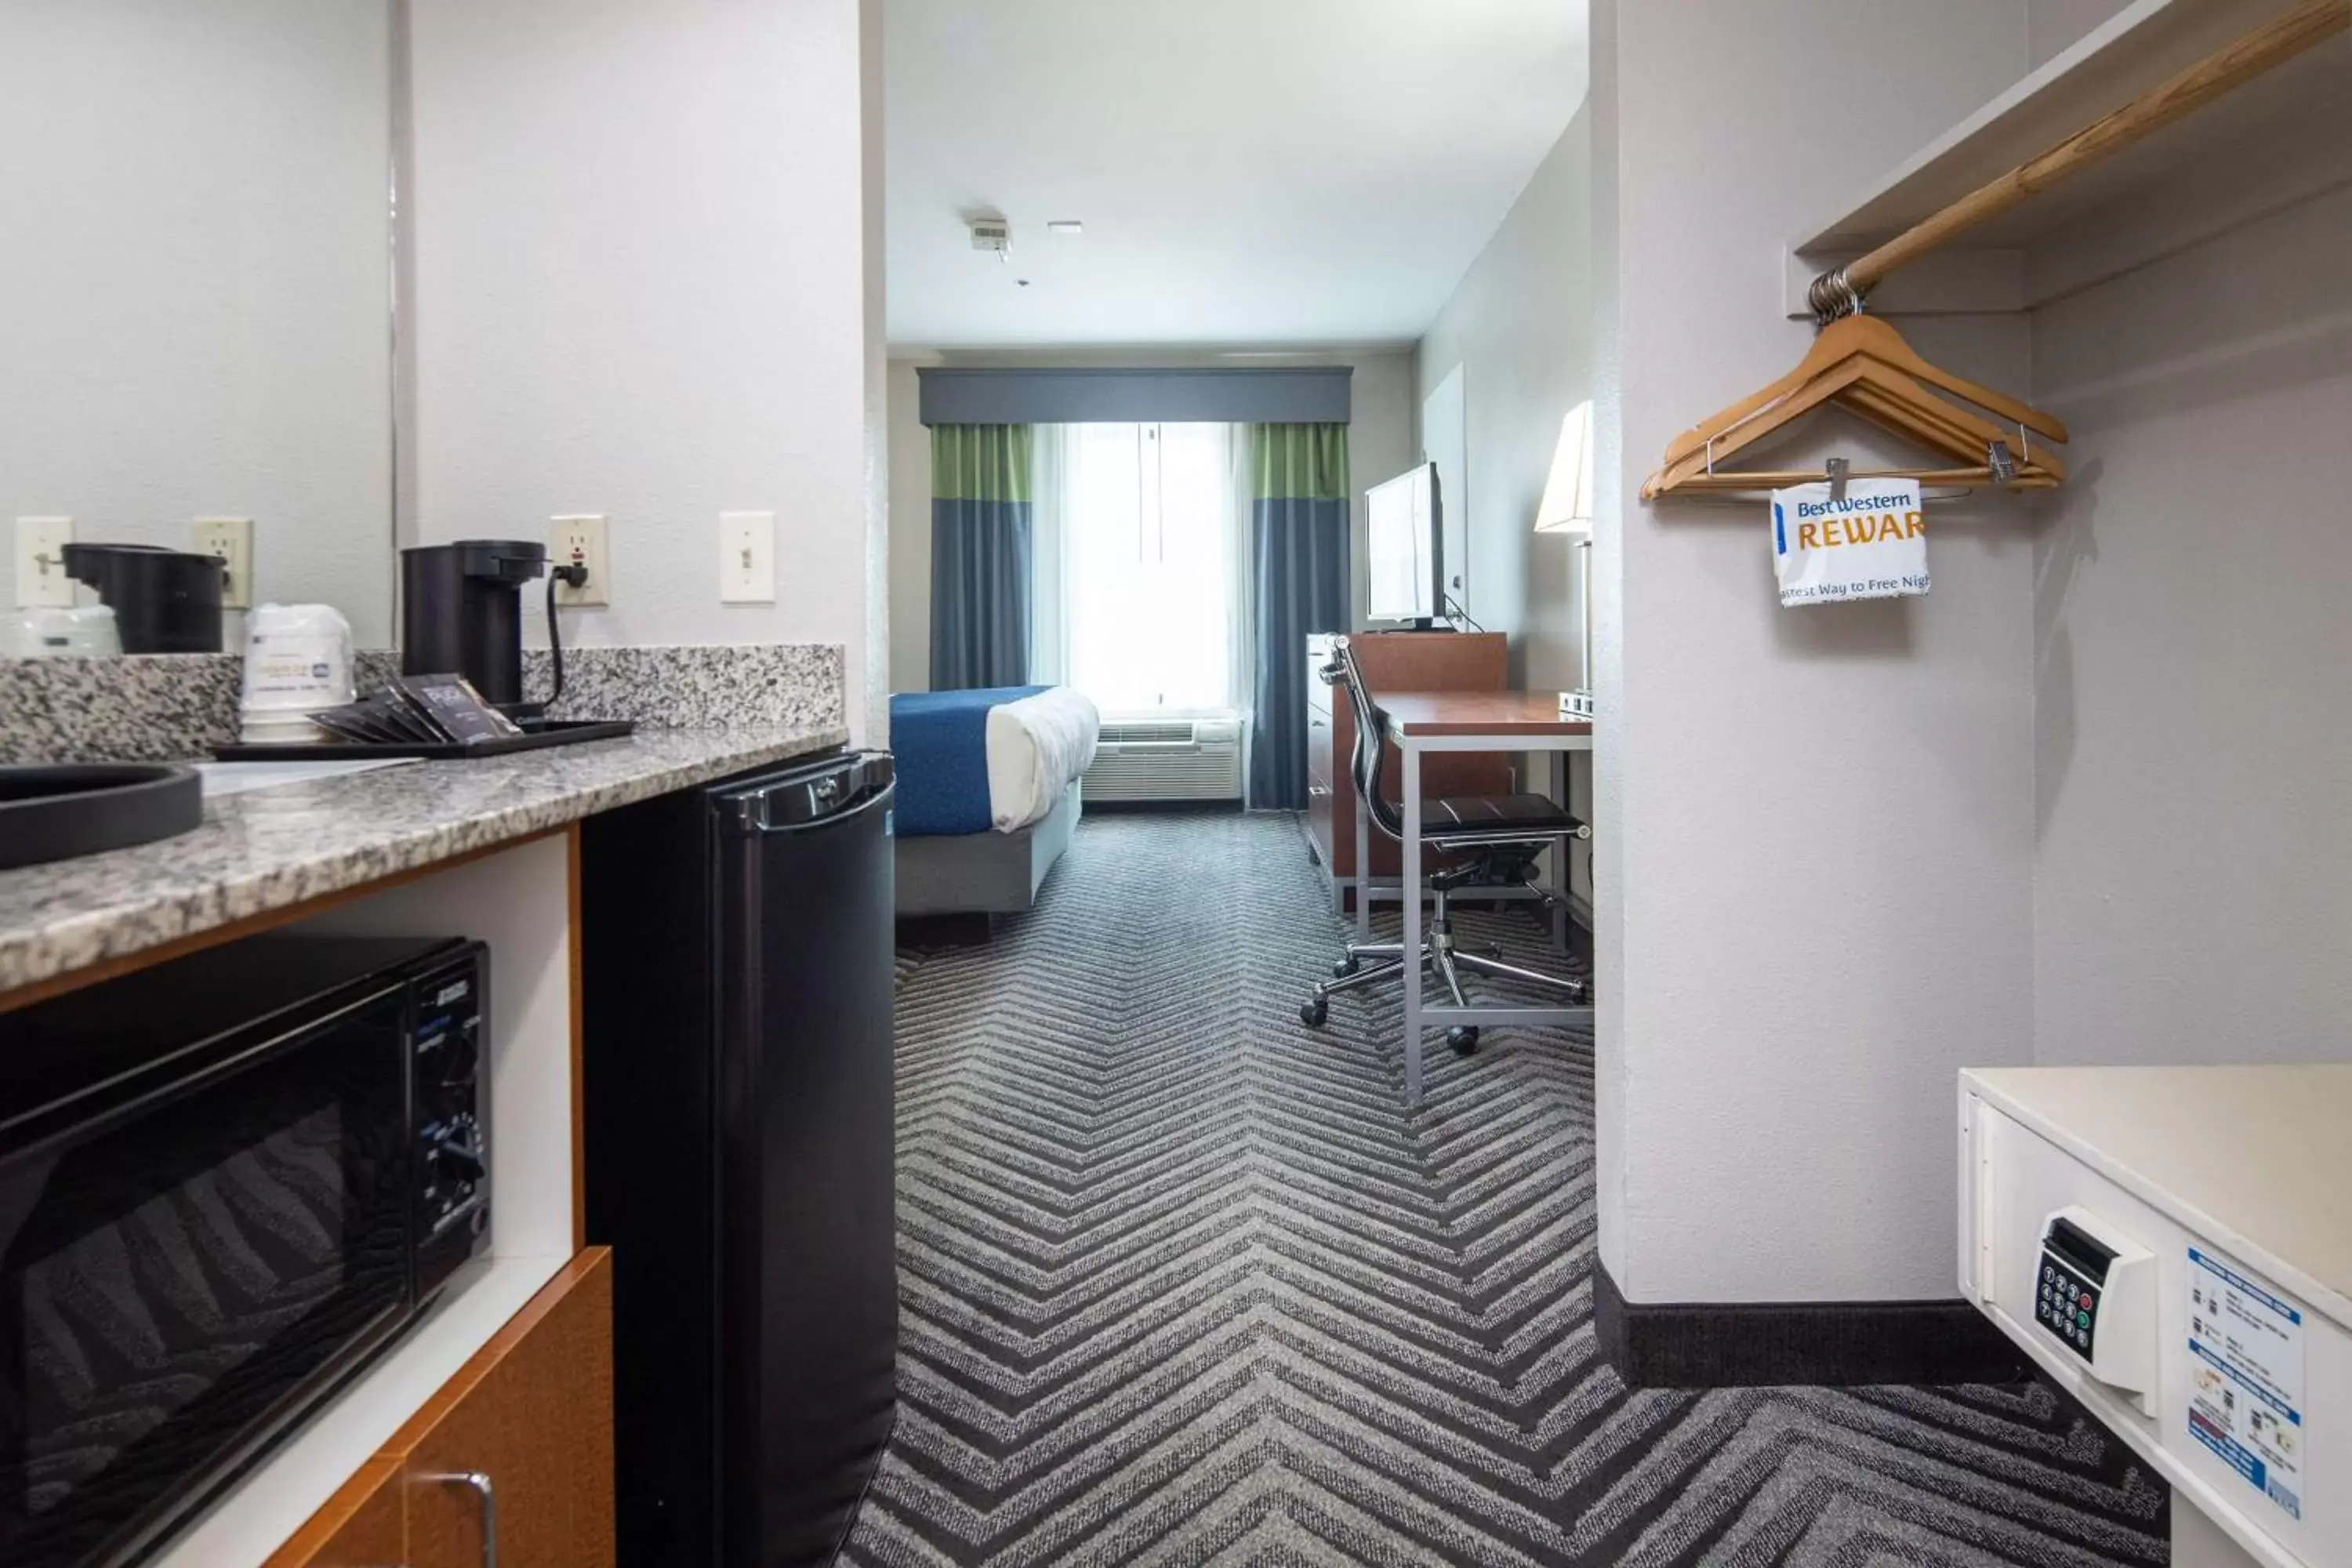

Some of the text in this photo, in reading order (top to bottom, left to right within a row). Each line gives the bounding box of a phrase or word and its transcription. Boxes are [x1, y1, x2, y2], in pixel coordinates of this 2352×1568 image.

[1798, 493, 1911, 517] Best Western
[1798, 510, 1926, 551] REWAR
[1818, 583, 1847, 597] Way
[1851, 582, 1865, 593] to
[1868, 579, 1898, 590] Free
